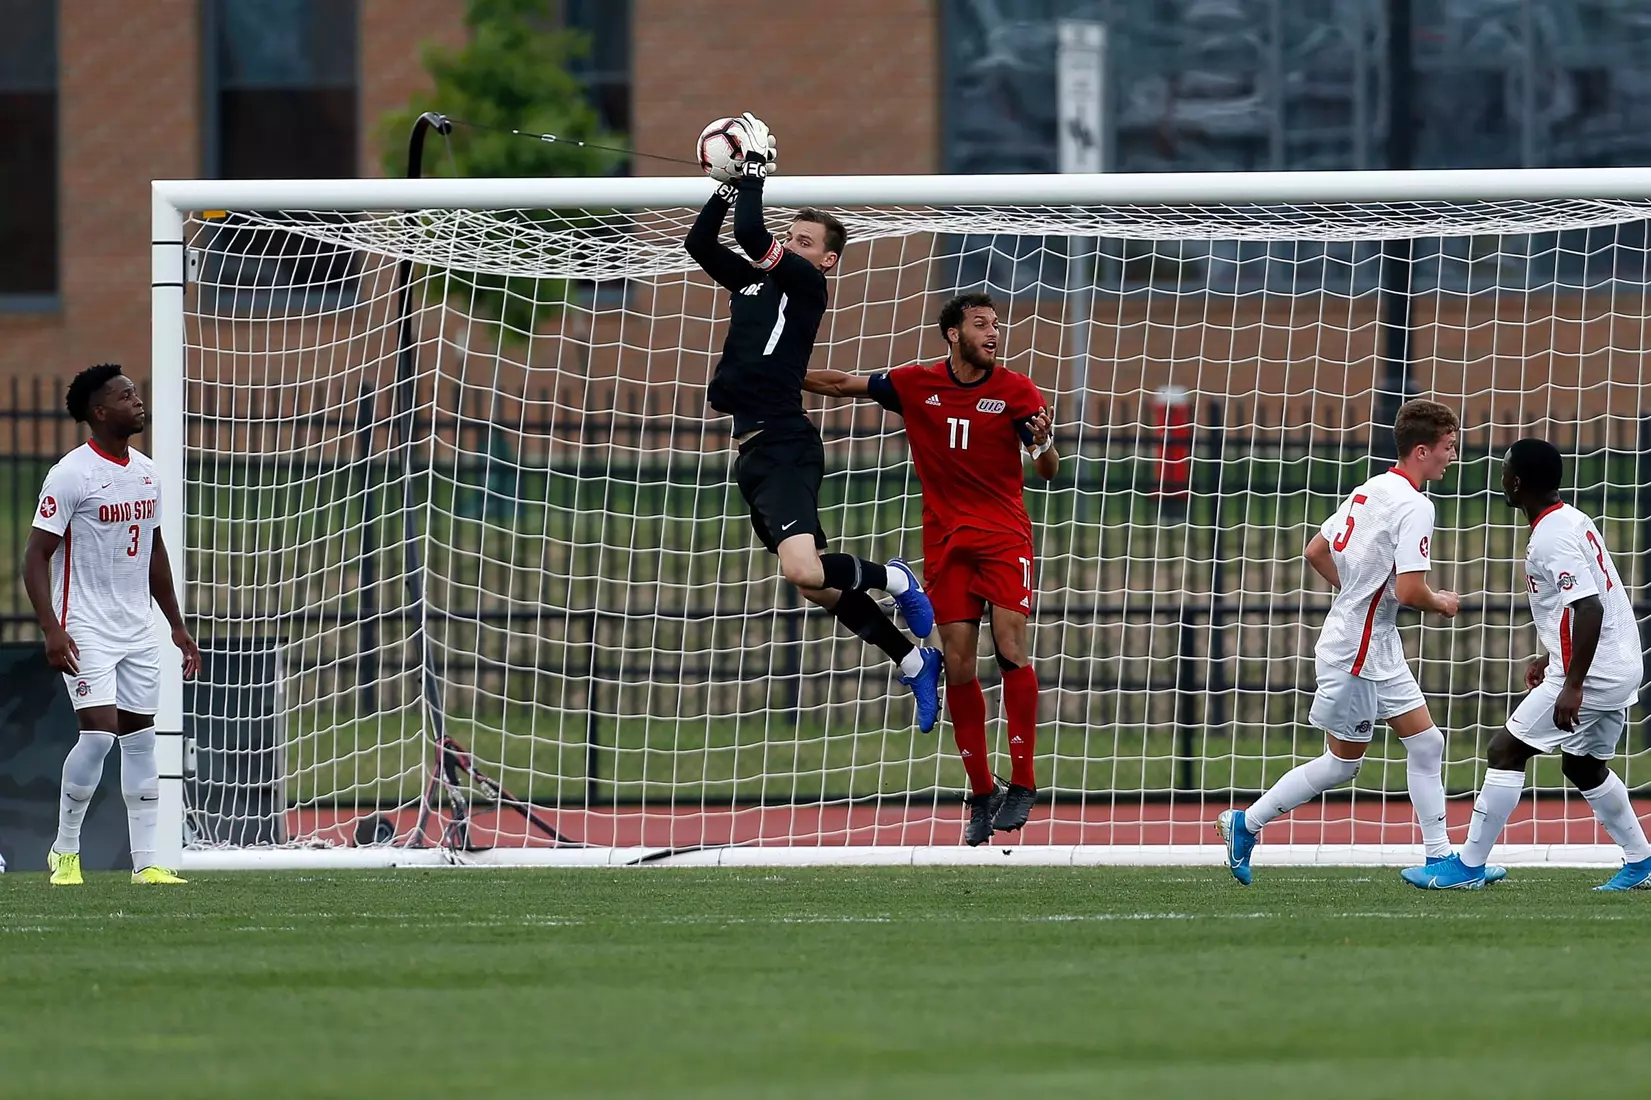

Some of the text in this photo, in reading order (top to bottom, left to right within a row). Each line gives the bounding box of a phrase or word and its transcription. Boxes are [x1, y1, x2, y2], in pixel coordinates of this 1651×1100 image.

[947, 417, 970, 450] 11
[98, 501, 132, 523] OHIO
[1332, 494, 1368, 553] 5
[127, 524, 140, 557] 3
